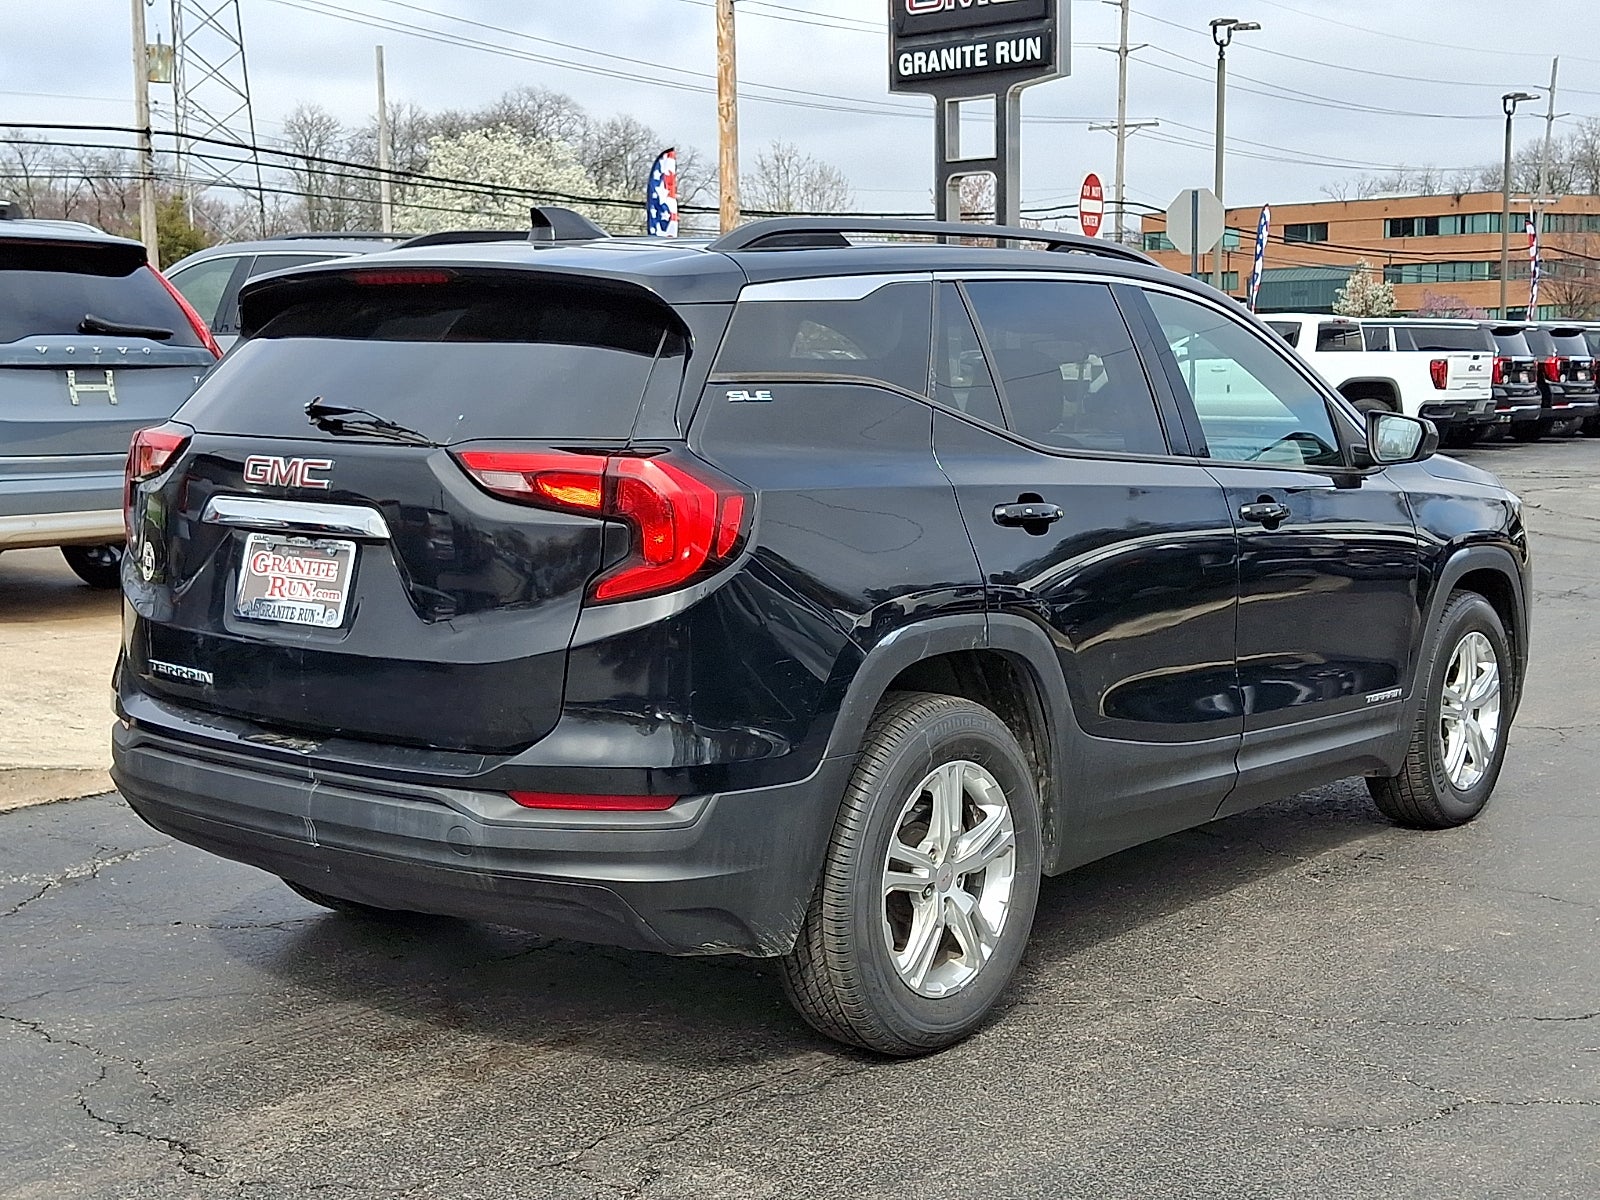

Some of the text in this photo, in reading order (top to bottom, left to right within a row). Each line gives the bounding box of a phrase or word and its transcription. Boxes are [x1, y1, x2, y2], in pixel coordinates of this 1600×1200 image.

[898, 36, 1041, 76] GRANITE RUN
[1083, 184, 1101, 198] DO NOT
[1083, 214, 1099, 227] ENTER
[35, 346, 151, 355] VOLVO
[726, 390, 773, 402] SLE
[243, 455, 334, 489] GMC
[252, 552, 338, 578] GRANITE
[259, 603, 298, 621] GRANITE
[297, 607, 316, 623] RUN
[148, 659, 213, 684] TERRAIN
[1365, 688, 1402, 704] TERRAIN
